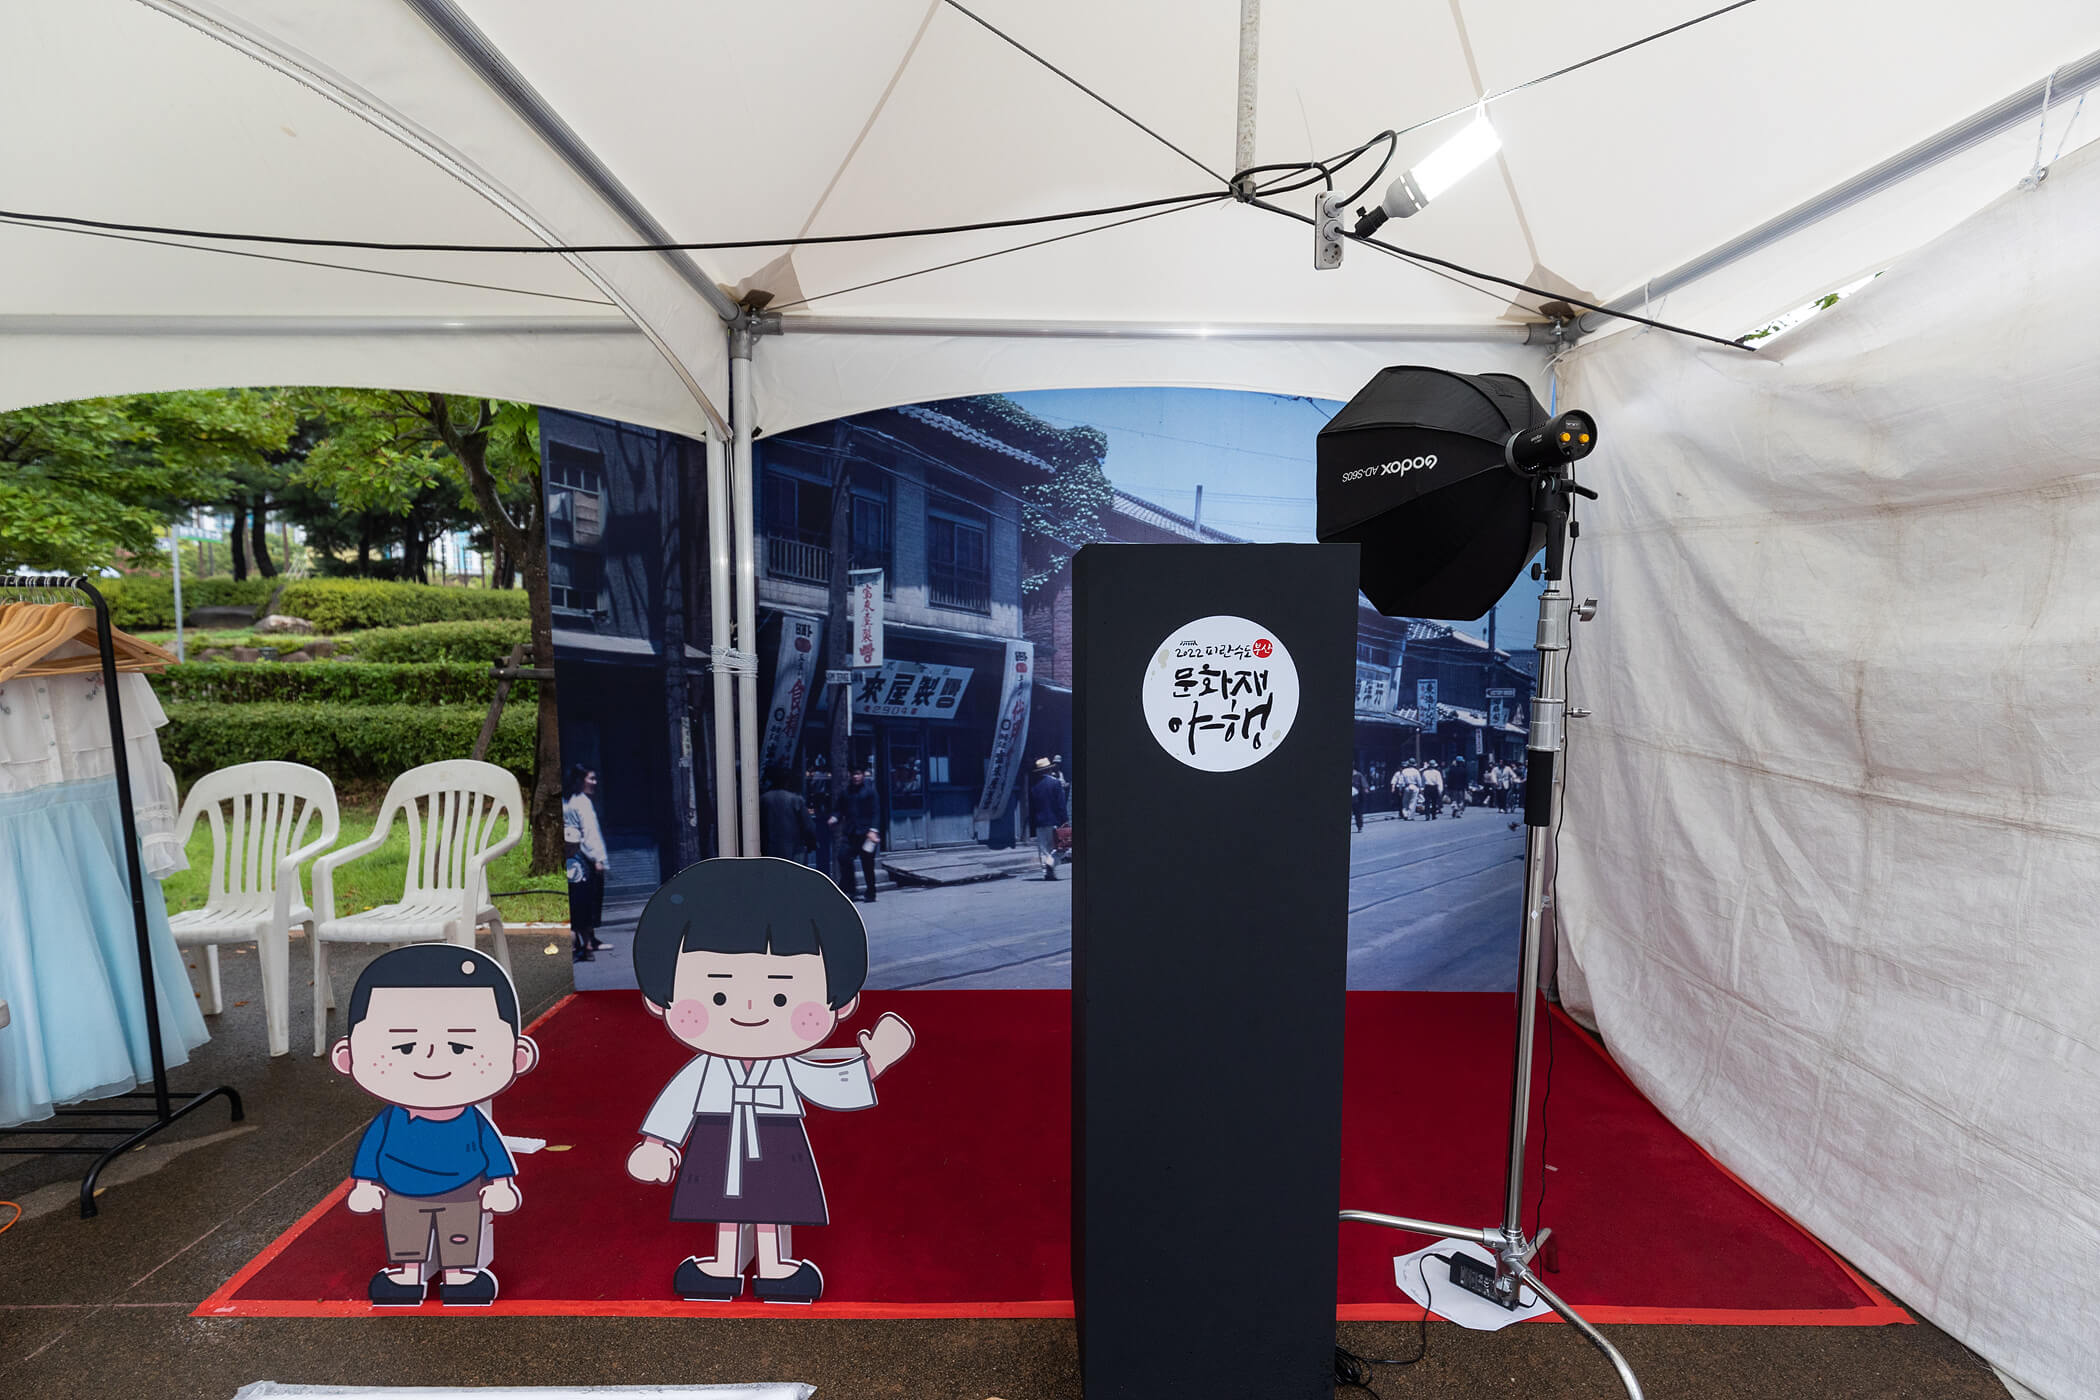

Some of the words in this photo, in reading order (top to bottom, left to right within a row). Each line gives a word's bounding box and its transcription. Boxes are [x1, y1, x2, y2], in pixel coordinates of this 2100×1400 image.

[1380, 454, 1438, 478] Godox
[1175, 648, 1204, 658] 2022
[1205, 644, 1252, 660] 피란수도
[1253, 641, 1273, 657] 부산
[1173, 664, 1268, 700] 문화재
[1168, 692, 1273, 755] 야행
